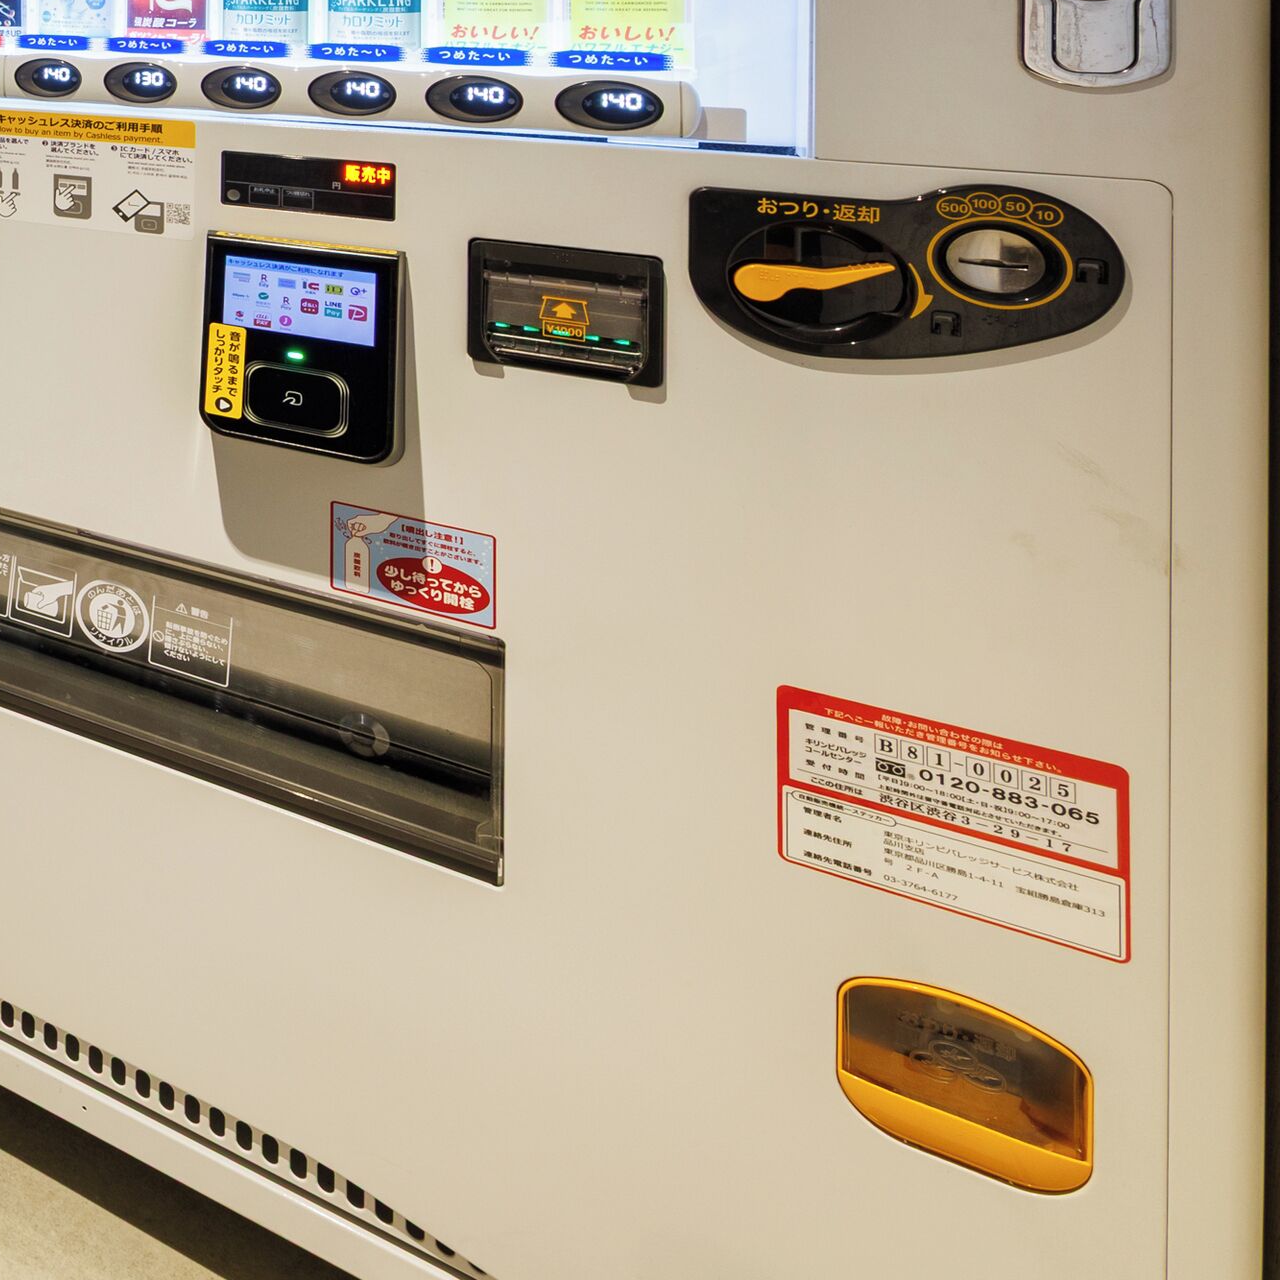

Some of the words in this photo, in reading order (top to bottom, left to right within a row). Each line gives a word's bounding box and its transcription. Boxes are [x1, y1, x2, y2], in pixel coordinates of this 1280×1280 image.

[236, 14, 291, 26] カロリミット
[343, 15, 402, 27] カロリミット
[451, 24, 539, 40] おいしい!
[579, 26, 674, 40] おいしい!
[44, 68, 70, 81] 140
[235, 77, 266, 91] 140
[346, 81, 380, 96] 140
[602, 93, 642, 110] 140
[74, 130, 83, 138] by
[86, 132, 120, 140] Cashless
[124, 134, 163, 143] payment.
[120, 153, 192, 163] にて決済してください。
[345, 165, 390, 185] 販売中
[332, 181, 341, 190] 円
[757, 198, 881, 223] おつり・返却
[941, 203, 967, 214] 500
[972, 199, 996, 209] 100
[1006, 202, 1025, 212] 50
[1036, 211, 1053, 221] 10
[212, 329, 226, 394] しっかりタッチ
[228, 331, 241, 397] 音が鳴るまで
[384, 565, 481, 598] 少し待ってから
[88, 586, 141, 615] のんだあとは
[391, 580, 475, 611] ゆっくり開栓
[91, 627, 133, 647] リサイクル
[881, 714, 1003, 750] 故障・お問い合わせの際は
[805, 738, 867, 758] キリンビバレッジ
[805, 746, 862, 765] コールセンター
[811, 776, 863, 796] ここの住所は
[919, 769, 1100, 825] 0120-883-065
[803, 807, 842, 823] 管理者名
[803, 828, 852, 848] 連絡先住所
[883, 838, 925, 855] 品川支店
[803, 850, 873, 877] 連絡先電話番号
[884, 874, 958, 901] 03-3764-6177
